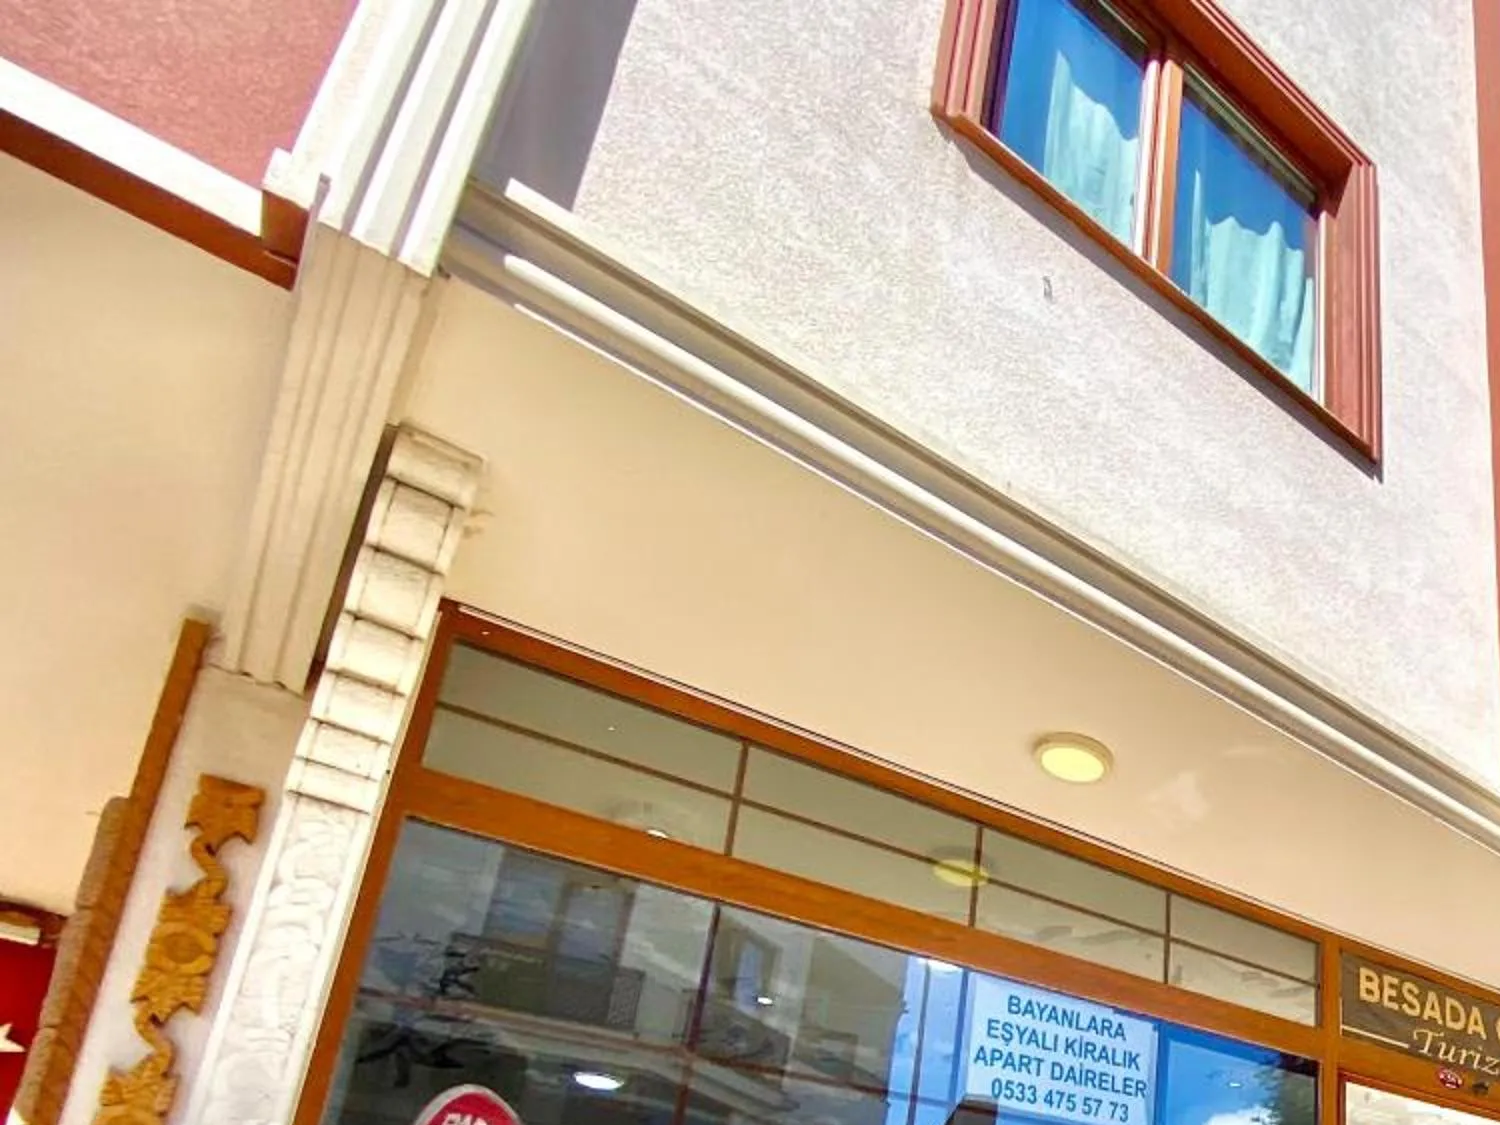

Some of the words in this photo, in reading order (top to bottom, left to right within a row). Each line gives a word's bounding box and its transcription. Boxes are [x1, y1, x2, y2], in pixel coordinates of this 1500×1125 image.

[1007, 994, 1127, 1041] BAYANLARA
[1358, 966, 1488, 1040] BESADA
[973, 1045, 1045, 1077] APART
[1050, 1062, 1148, 1099] DAİRELER
[986, 1018, 1059, 1053] EŞYALI
[1063, 1035, 1141, 1072] KİRALIK
[991, 1078, 1037, 1104] 0533
[1043, 1089, 1077, 1113] 475
[1081, 1097, 1103, 1116] 57
[1109, 1103, 1129, 1123] 73
